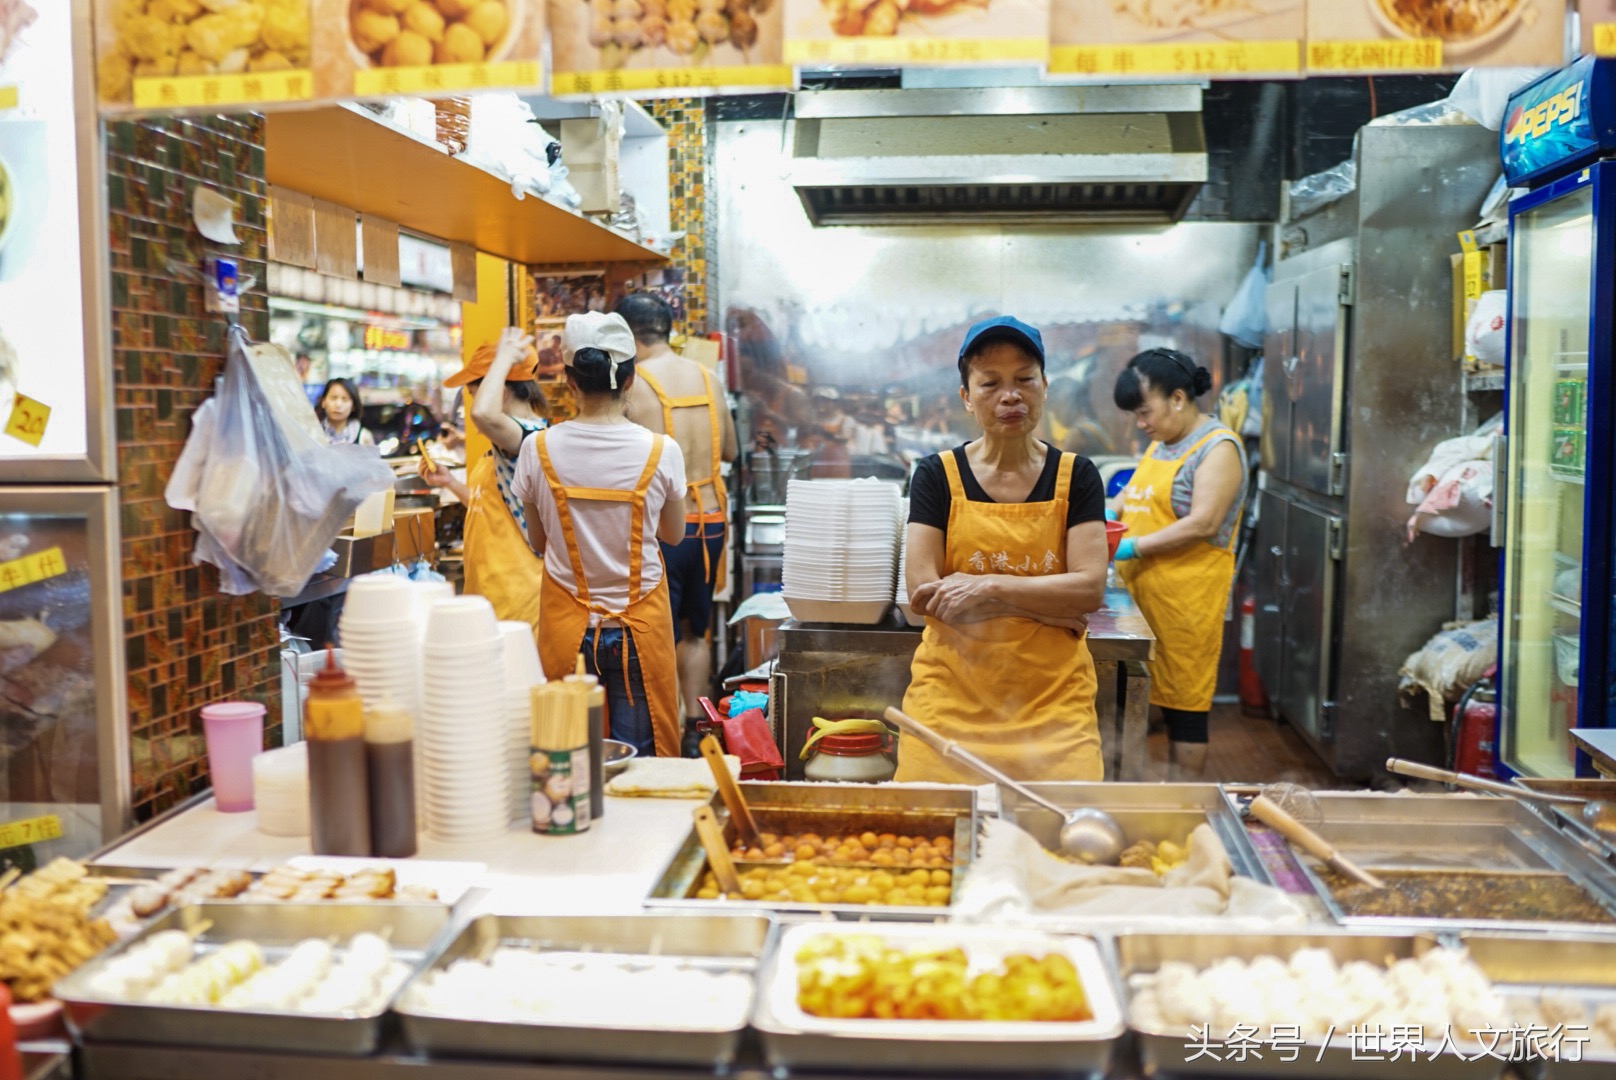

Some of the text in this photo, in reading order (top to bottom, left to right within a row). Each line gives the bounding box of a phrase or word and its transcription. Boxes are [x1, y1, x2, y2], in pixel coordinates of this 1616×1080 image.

[1519, 80, 1584, 144] PEPSI
[968, 549, 1059, 573] 香港小食
